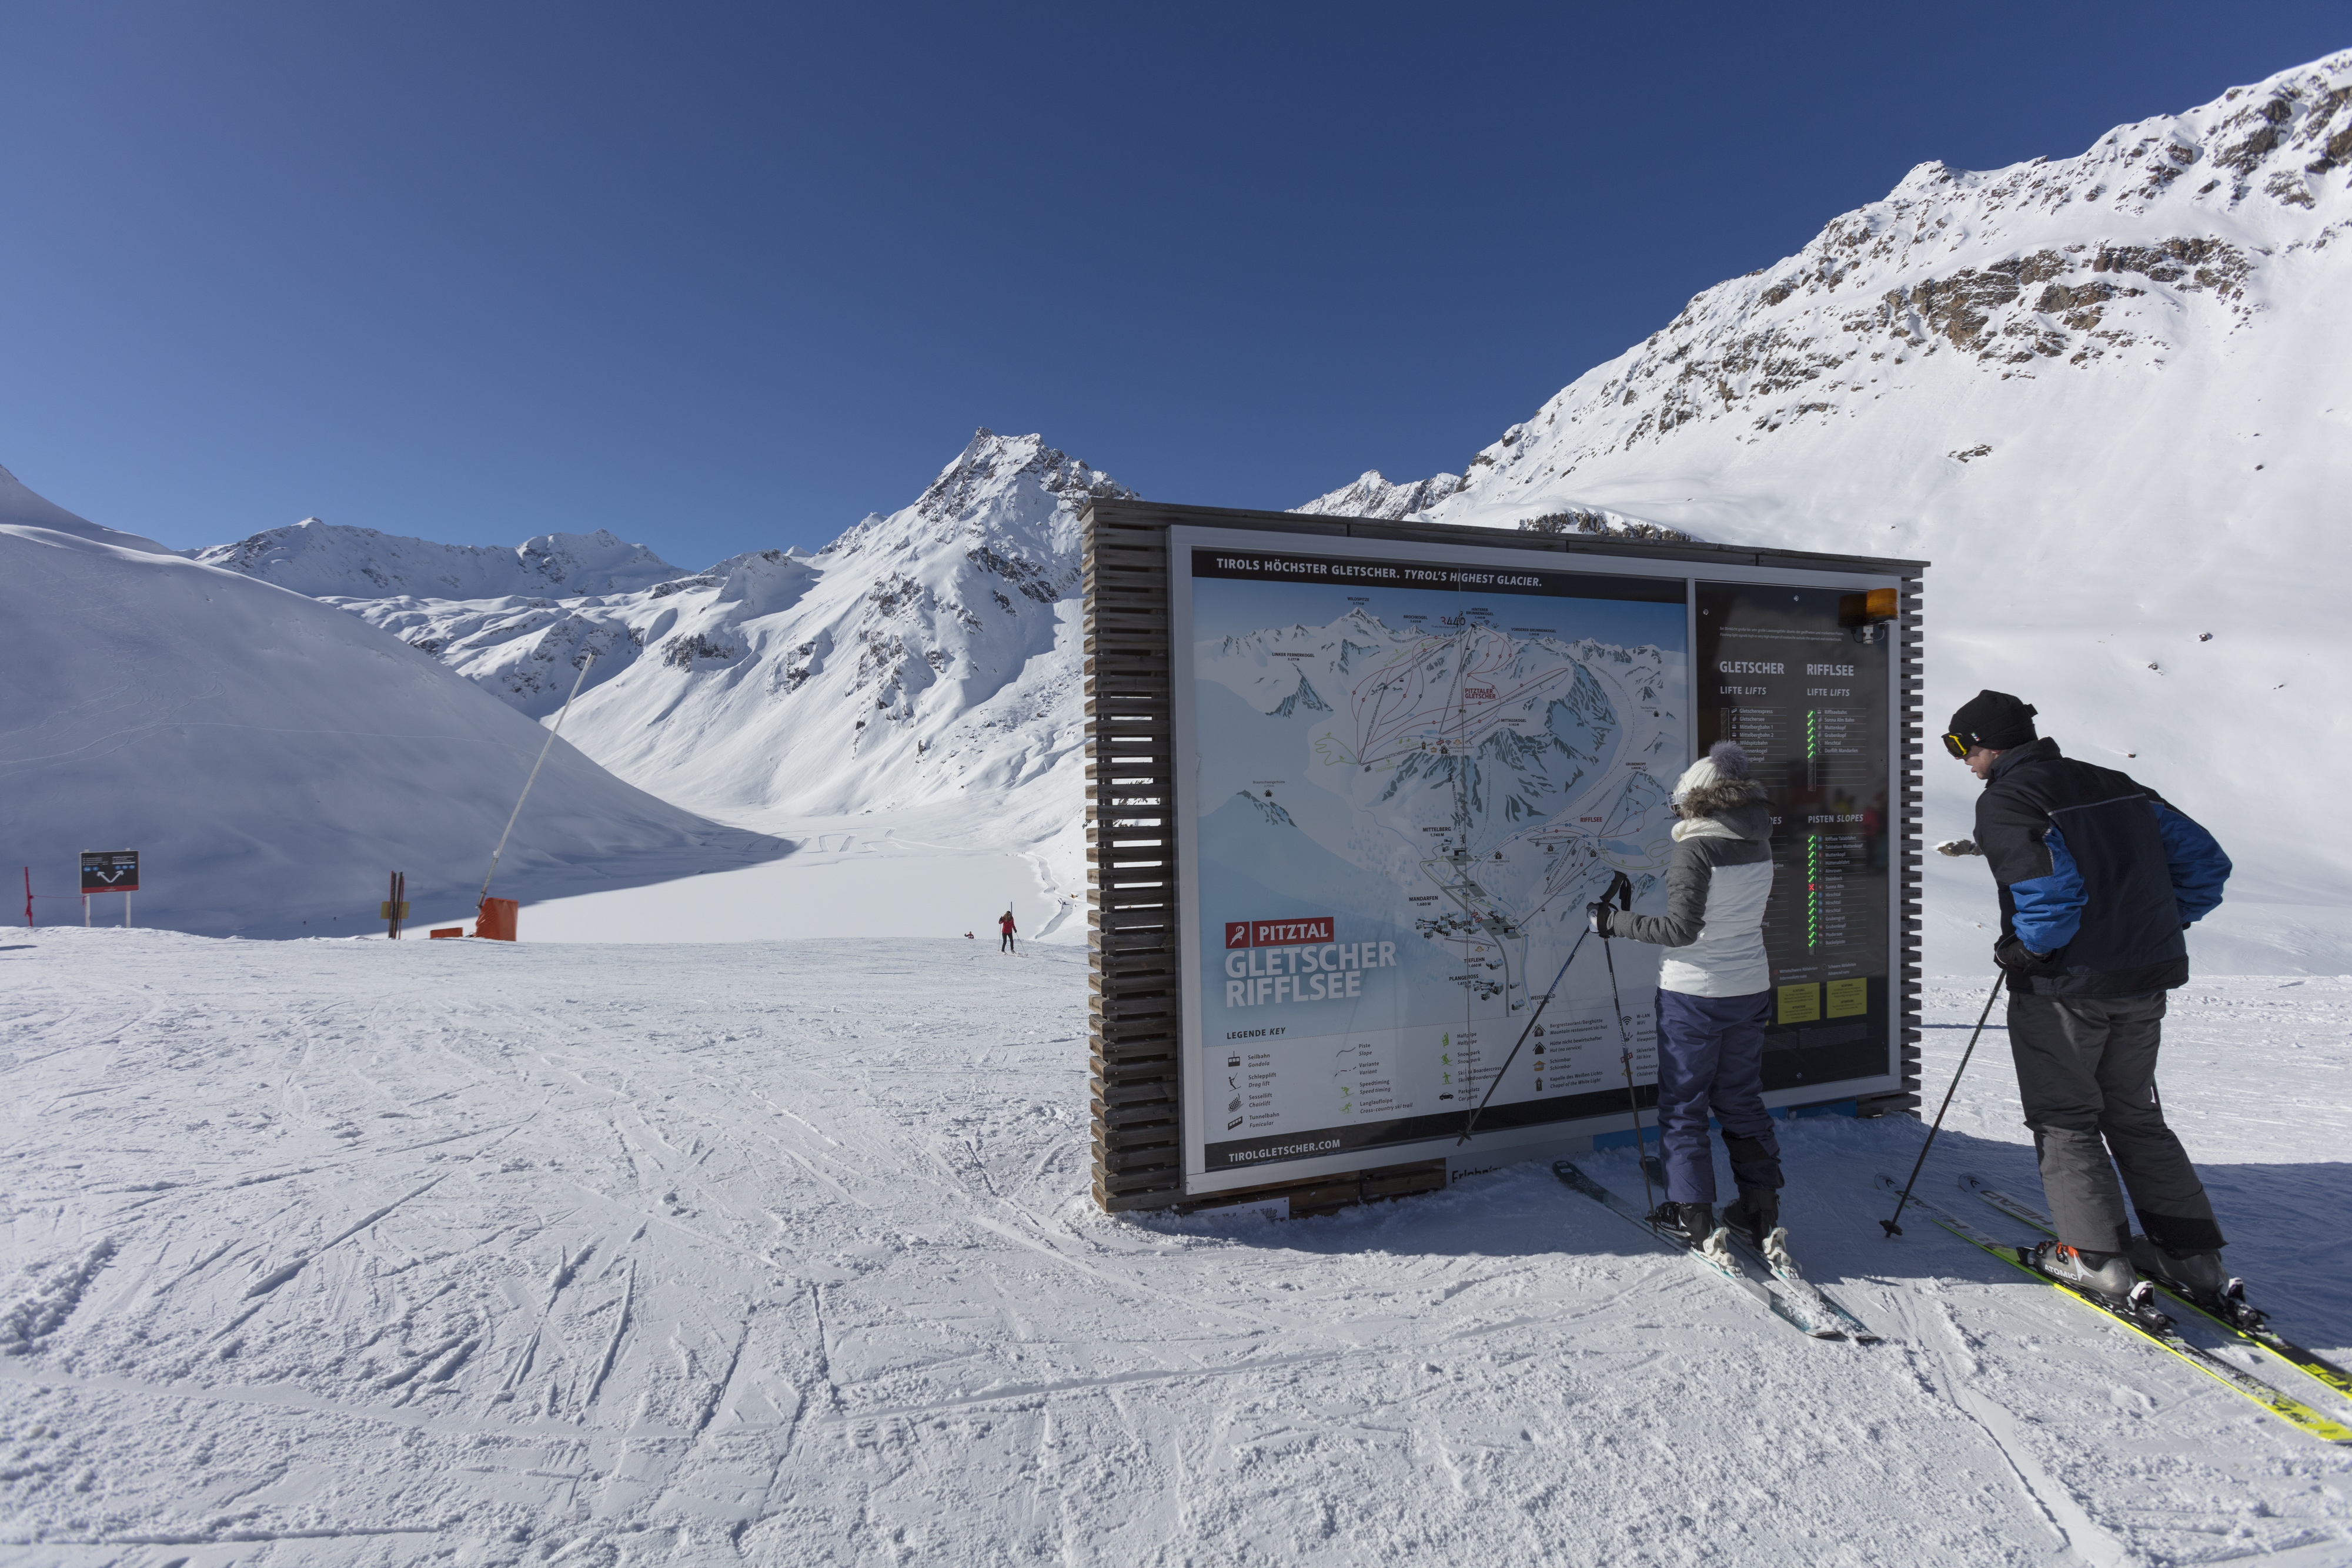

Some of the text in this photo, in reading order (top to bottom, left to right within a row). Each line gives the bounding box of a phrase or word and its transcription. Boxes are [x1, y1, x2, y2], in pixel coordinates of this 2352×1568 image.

[1217, 558, 1259, 570] TIROLS
[1264, 559, 1327, 574] HÖCHSTER
[1331, 565, 1399, 578] GLETSCHER.
[1450, 571, 1494, 584] HIGHEST
[1497, 575, 1542, 587] GLACIER.
[1407, 654, 1434, 672] MITTELBERGBAHN
[1719, 660, 1785, 675] GLETSCHER
[1807, 663, 1853, 676] RIFFLSEE
[1595, 666, 1623, 690] VARIANTE TASCHACHTAL
[1446, 676, 1458, 706] WILDSPITZBAHN
[1506, 688, 1530, 703] BRUNNENKOGEL
[1720, 686, 1766, 695] LIFTE LIFTS
[1807, 687, 1850, 697] LIFTE LIFTS
[1367, 704, 1380, 737] MITTELBERGBAHN
[1472, 723, 1494, 739] MITTAGSKOGEL
[1385, 748, 1409, 760] GLETSCHERSEE
[1610, 795, 1623, 818] GRUBENKOPF
[1808, 814, 1864, 823] PISTEN SLOPES
[1595, 870, 1612, 879] HIRSCHTAL
[1558, 875, 1577, 892] RIFFLSEEBAHN
[1258, 922, 1329, 942] PITZTAL
[1225, 941, 1397, 978] GLETSCHER
[1226, 970, 1361, 1008] RIFFLSEE
[1549, 1018, 1603, 1028] Bergrestaurant/Berghütte
[1227, 1027, 1286, 1039] LEGENDE KEY
[1457, 1031, 1477, 1039] Halfpipe
[1571, 1025, 1599, 1034] restaurant/ski
[1248, 1060, 1270, 1068] Gondola
[1636, 1062, 1658, 1071] Kinderland
[1248, 1071, 1277, 1081] Schlepplift
[1359, 1078, 1390, 1088] Speedtiming
[1550, 1081, 1565, 1089] Chapel
[1359, 1085, 1391, 1096] Speed timing
[1458, 1086, 1480, 1095] Parkplatz
[1248, 1092, 1272, 1101] Sessellift
[1249, 1099, 1271, 1108] Chairlift
[1360, 1097, 1393, 1108] Langlaufloipe
[1360, 1105, 1394, 1115] Cross-country
[1250, 1111, 1279, 1121] Tunnelbahn
[1250, 1119, 1274, 1128] Funicular
[1228, 1139, 1340, 1162] TIROLGLETSCHER.COM
[1661, 1221, 1677, 1230] ATOMIC
[2044, 1263, 2078, 1281] ATOMIC
